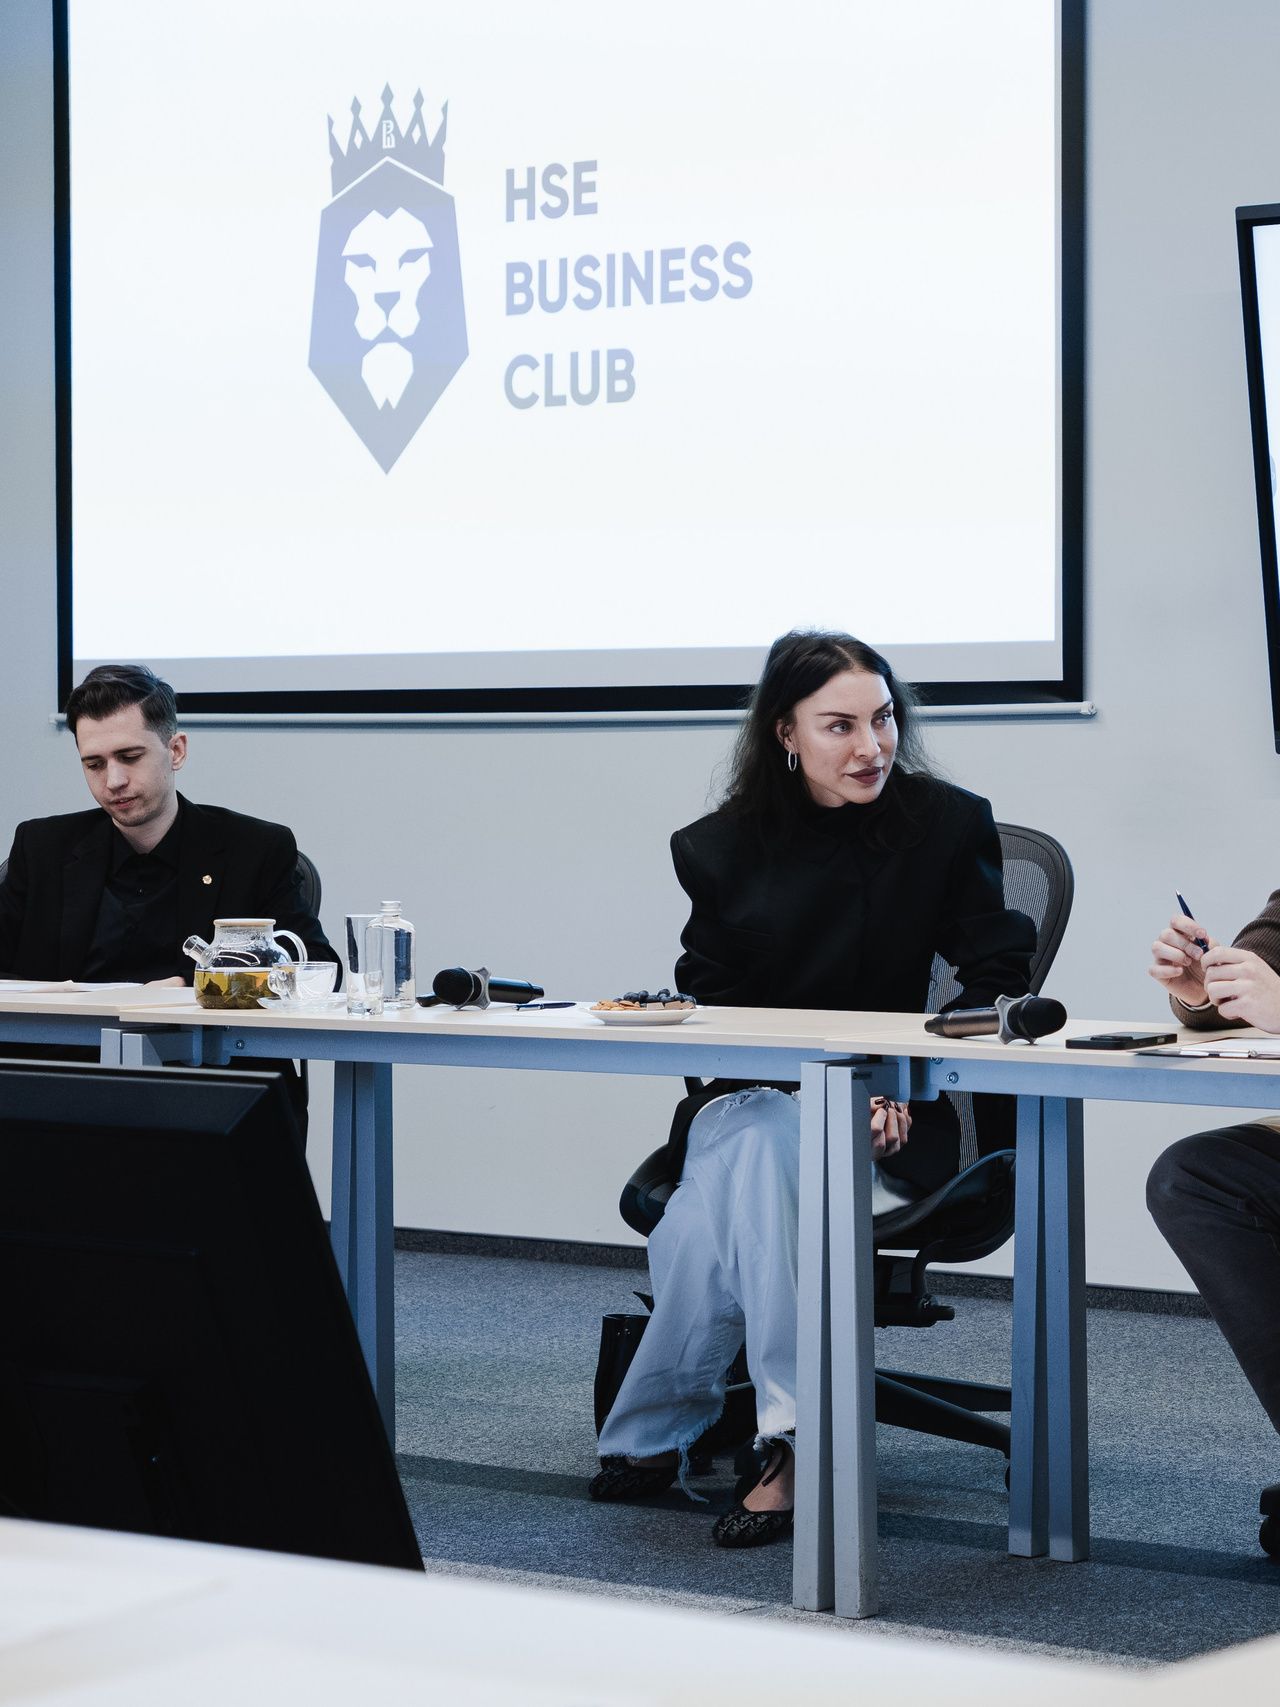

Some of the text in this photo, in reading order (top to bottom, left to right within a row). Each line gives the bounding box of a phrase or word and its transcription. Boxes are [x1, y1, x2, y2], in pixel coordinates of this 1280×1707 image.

[505, 159, 599, 223] HSE
[505, 241, 753, 317] BUSINESS
[503, 347, 636, 410] CLUB
